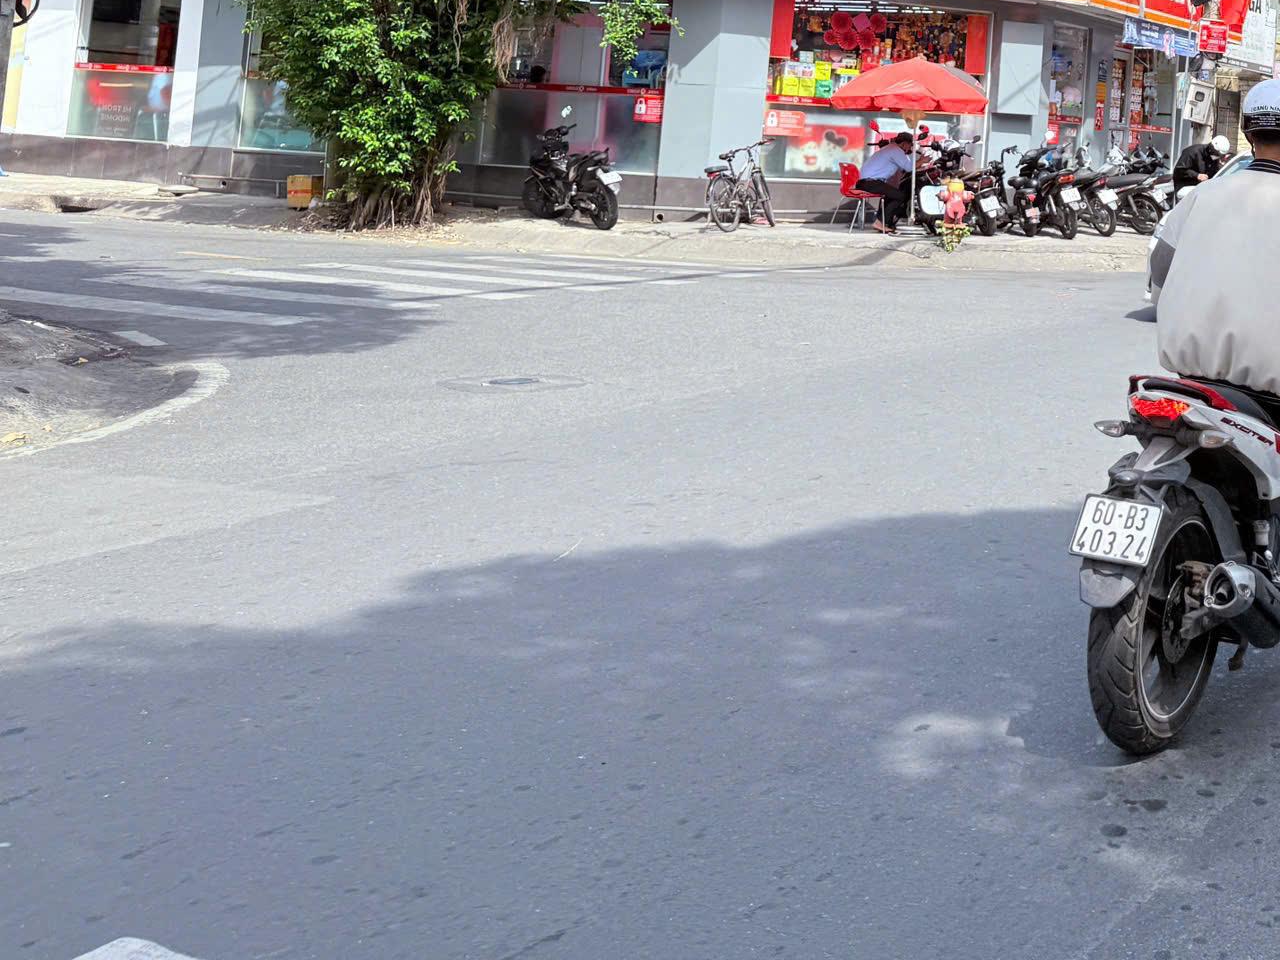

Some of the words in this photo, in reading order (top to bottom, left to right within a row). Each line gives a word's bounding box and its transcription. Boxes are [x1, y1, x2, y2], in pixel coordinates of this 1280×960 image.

[1220, 417, 1274, 446] EXCITER
[1092, 500, 1149, 531] 60-B3
[1076, 526, 1145, 561] 403.24
